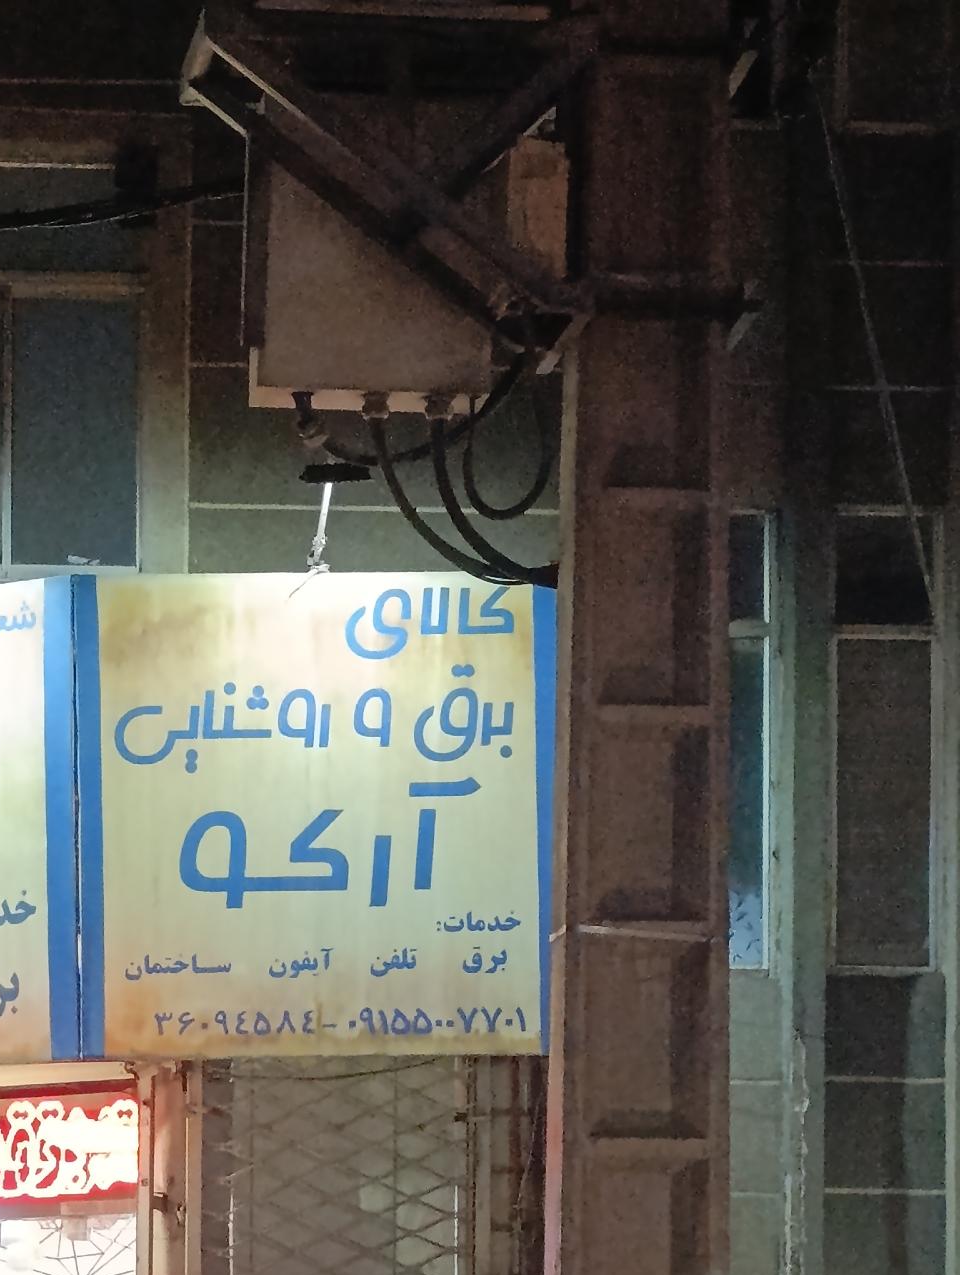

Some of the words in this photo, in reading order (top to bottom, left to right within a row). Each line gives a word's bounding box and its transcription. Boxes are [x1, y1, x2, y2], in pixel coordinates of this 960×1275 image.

[345, 586, 515, 660] کالای
[114, 681, 331, 774] روشنایی
[353, 687, 393, 747] و
[414, 664, 515, 762] برق
[178, 777, 482, 909] آرکو
[435, 909, 522, 933] خدمات:
[123, 953, 232, 981] ساختمان
[268, 947, 334, 979] آیفون
[369, 947, 417, 978] تلفن
[461, 945, 508, 974] برق
